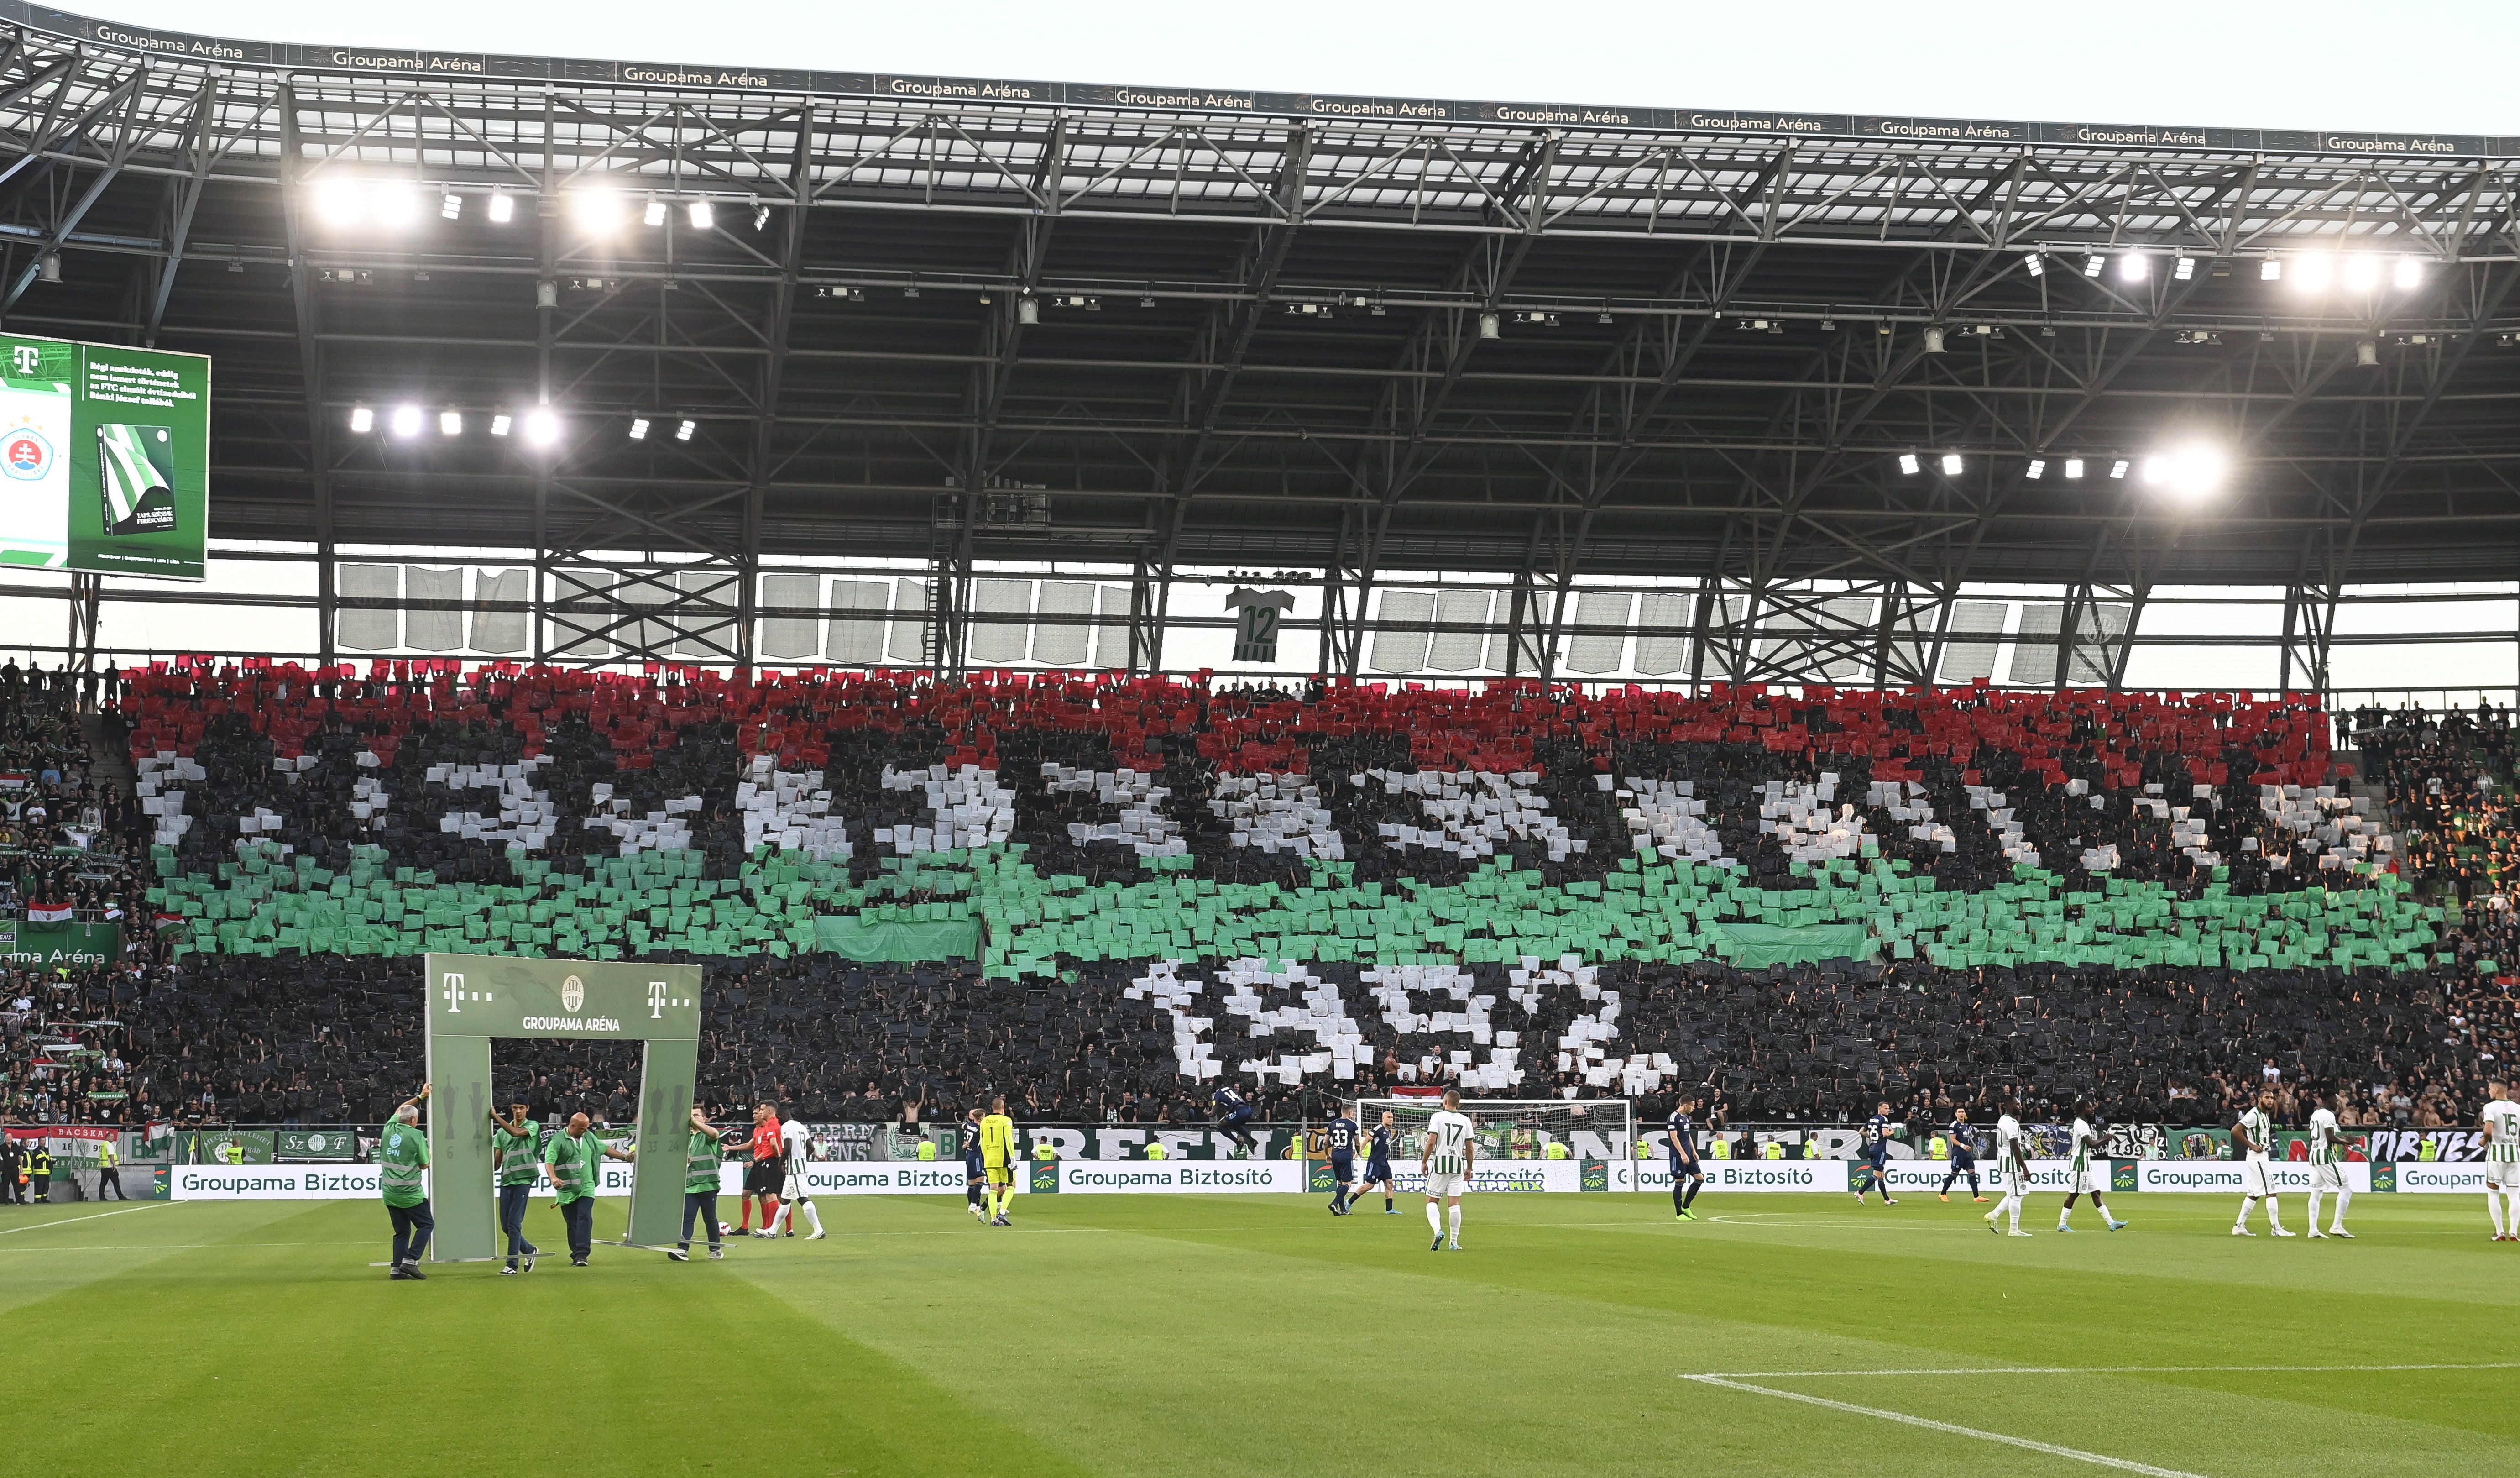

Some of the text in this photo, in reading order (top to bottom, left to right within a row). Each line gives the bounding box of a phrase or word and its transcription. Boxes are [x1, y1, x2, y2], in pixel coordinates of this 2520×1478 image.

[97, 26, 243, 58] Groupama Aréna
[333, 51, 481, 72] Groupama Aréna
[624, 67, 768, 87] Groupama Aréna
[891, 79, 1030, 99] Groupama Aréna
[1117, 90, 1252, 109] Groupama Aréna
[1312, 99, 1446, 117] Groupama Aréna
[1497, 106, 1629, 124] Groupama Aréna
[1691, 114, 1821, 131] Groupama Aréna
[1881, 121, 2010, 138] Groupama Aréna
[2078, 128, 2206, 144] Groupama Aréna
[2328, 136, 2454, 152] Groupama Aréna
[90, 362, 109, 372] Régi
[101, 383, 118, 391] FTC
[110, 374, 136, 384] ismert
[1244, 605, 1276, 644] 12
[49, 949, 105, 964] Aréna
[523, 1015, 620, 1032] GROUPAMA ARÉNA
[1868, 1124, 1879, 1140] 25
[2502, 1113, 2517, 1136] 15
[798, 1131, 805, 1150] 13
[989, 1126, 993, 1144] 1
[1333, 1129, 1348, 1146] 33
[1444, 1123, 1464, 1146] 17
[1009, 1129, 1272, 1160] REEN
[183, 1169, 382, 1193] Groupama Biztosí
[807, 1170, 967, 1190] oupama Biztos
[1069, 1168, 1272, 1188] Groupama Biztosító
[1725, 1168, 1812, 1184] Biztosító
[2147, 1169, 2242, 1188] Groupama
[2405, 1170, 2485, 1189] Groupam
